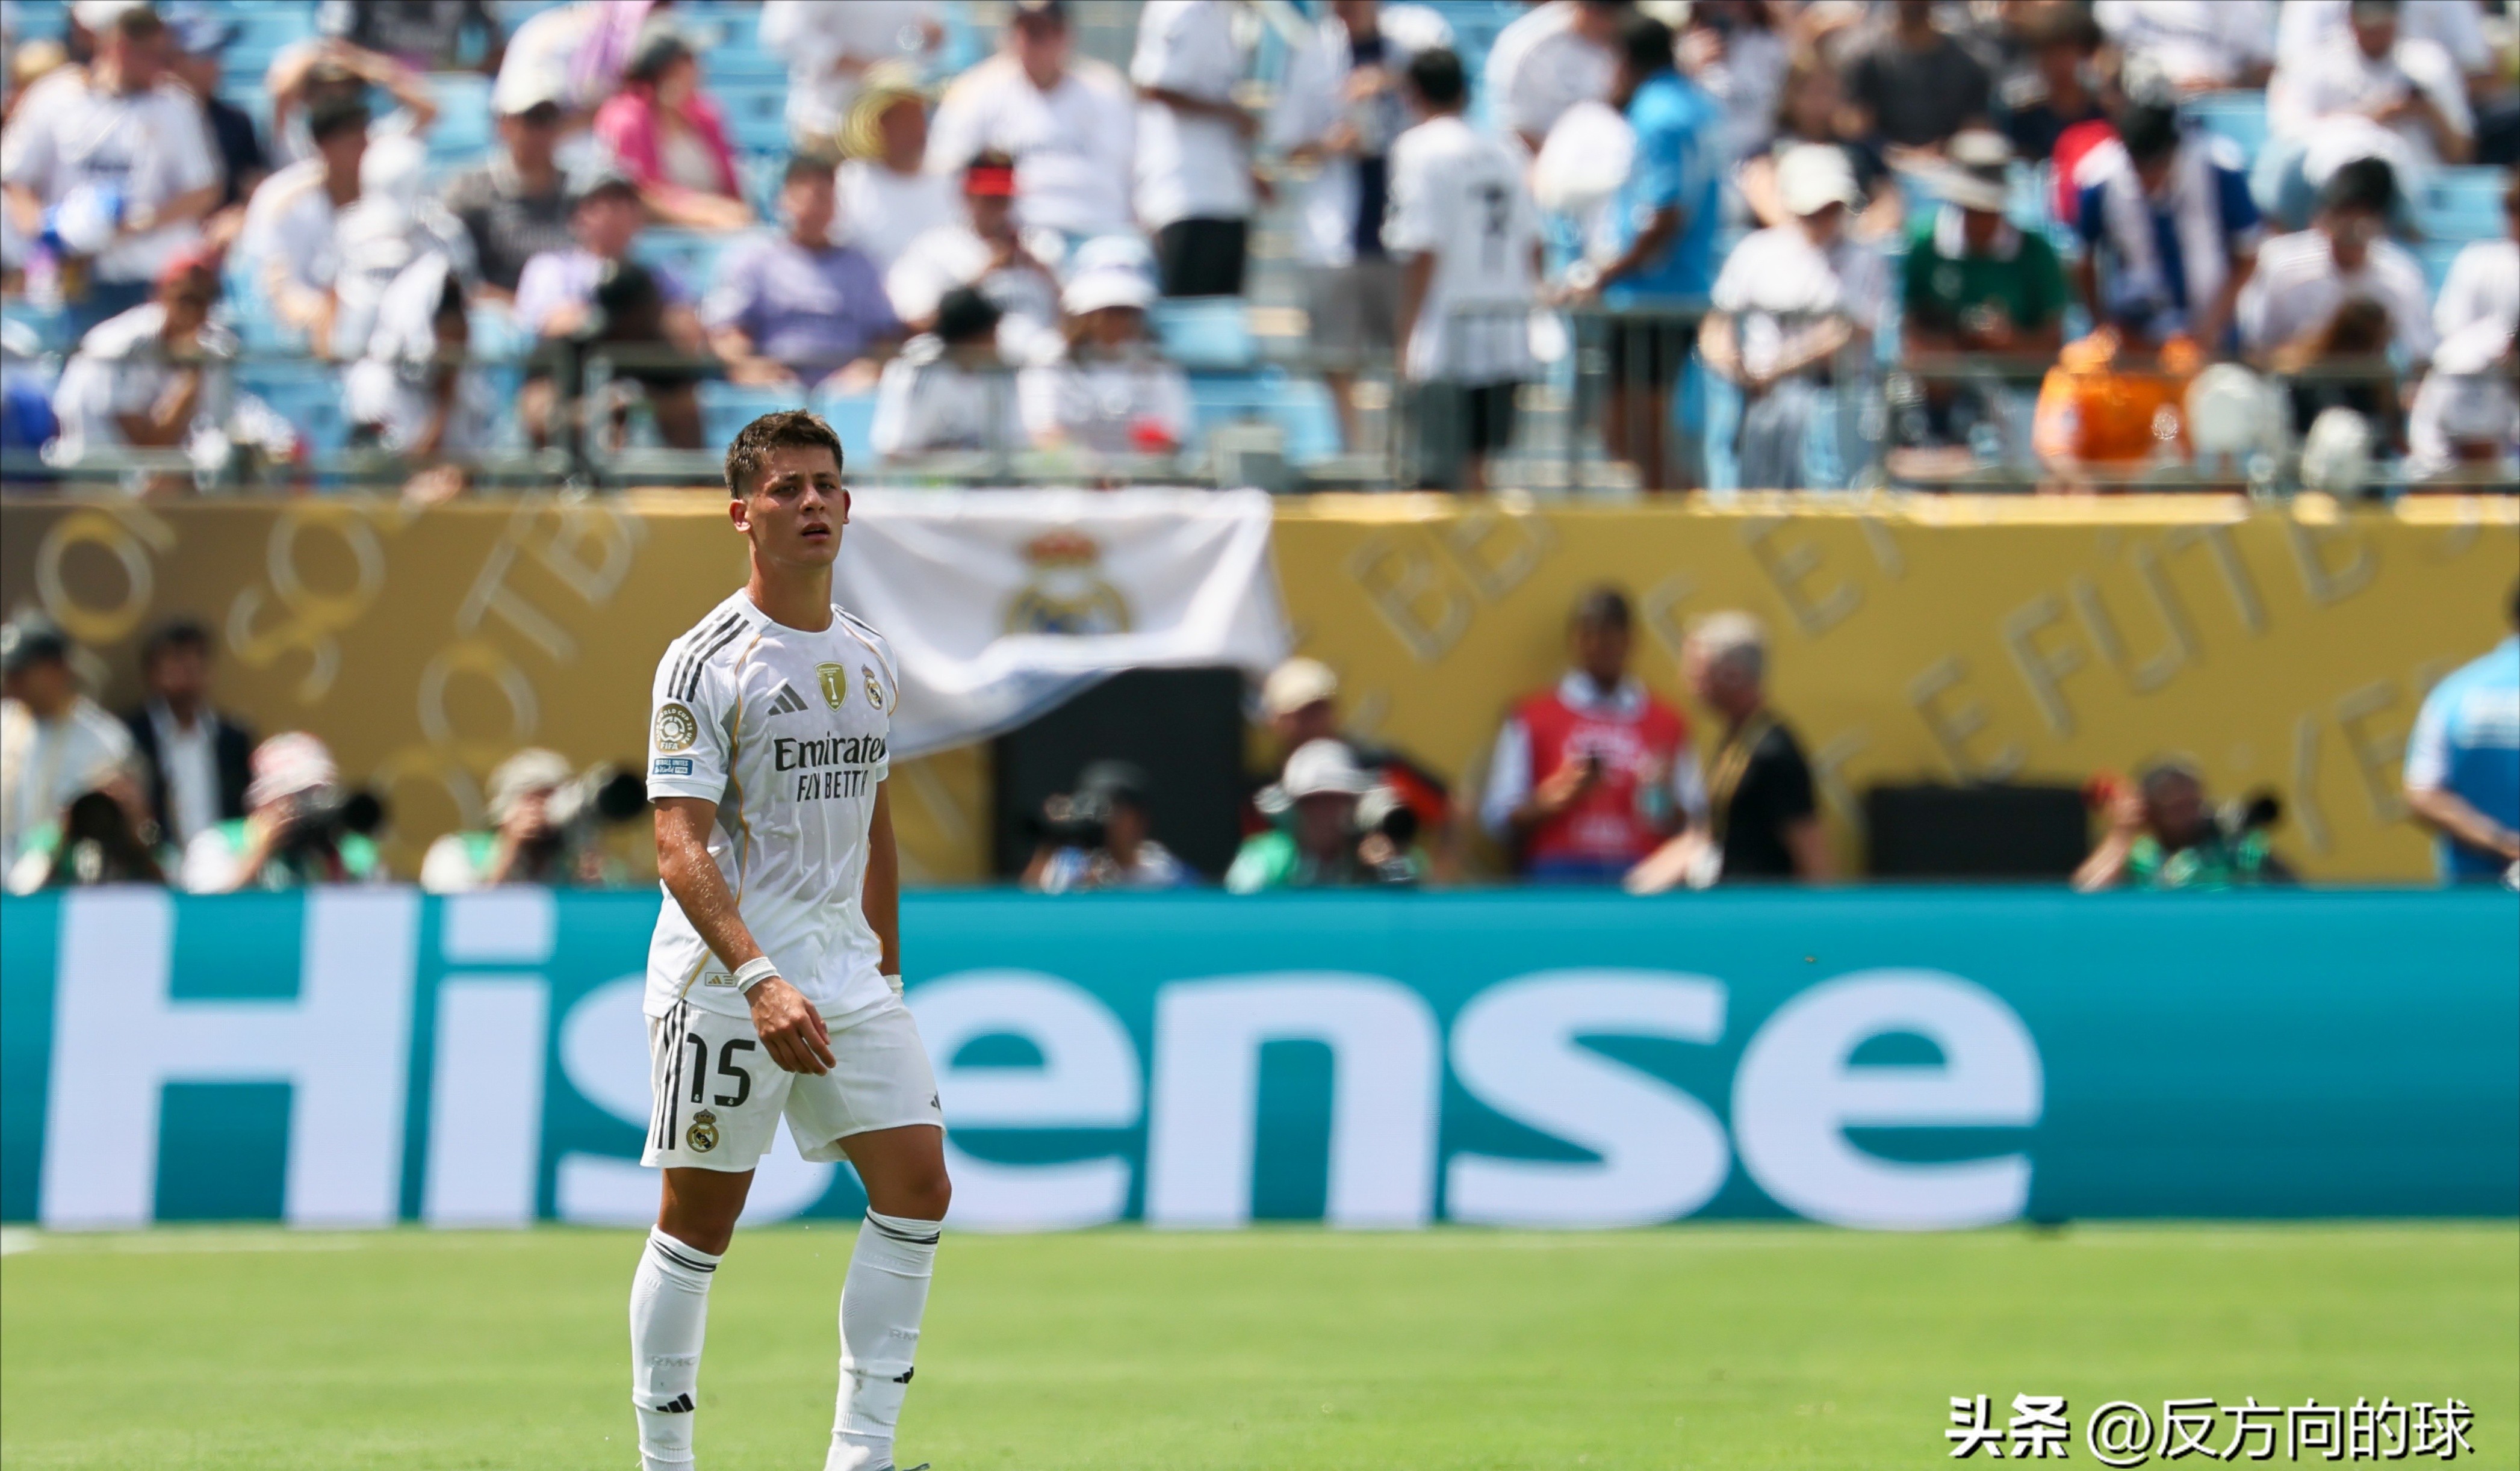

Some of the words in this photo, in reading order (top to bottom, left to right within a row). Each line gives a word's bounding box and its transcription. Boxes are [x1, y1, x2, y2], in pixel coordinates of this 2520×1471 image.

[677, 710, 689, 721] CUP
[660, 742, 679, 750] FIFA
[774, 731, 886, 772] Emirate
[796, 772, 821, 802] FLY
[687, 1032, 756, 1107] 15
